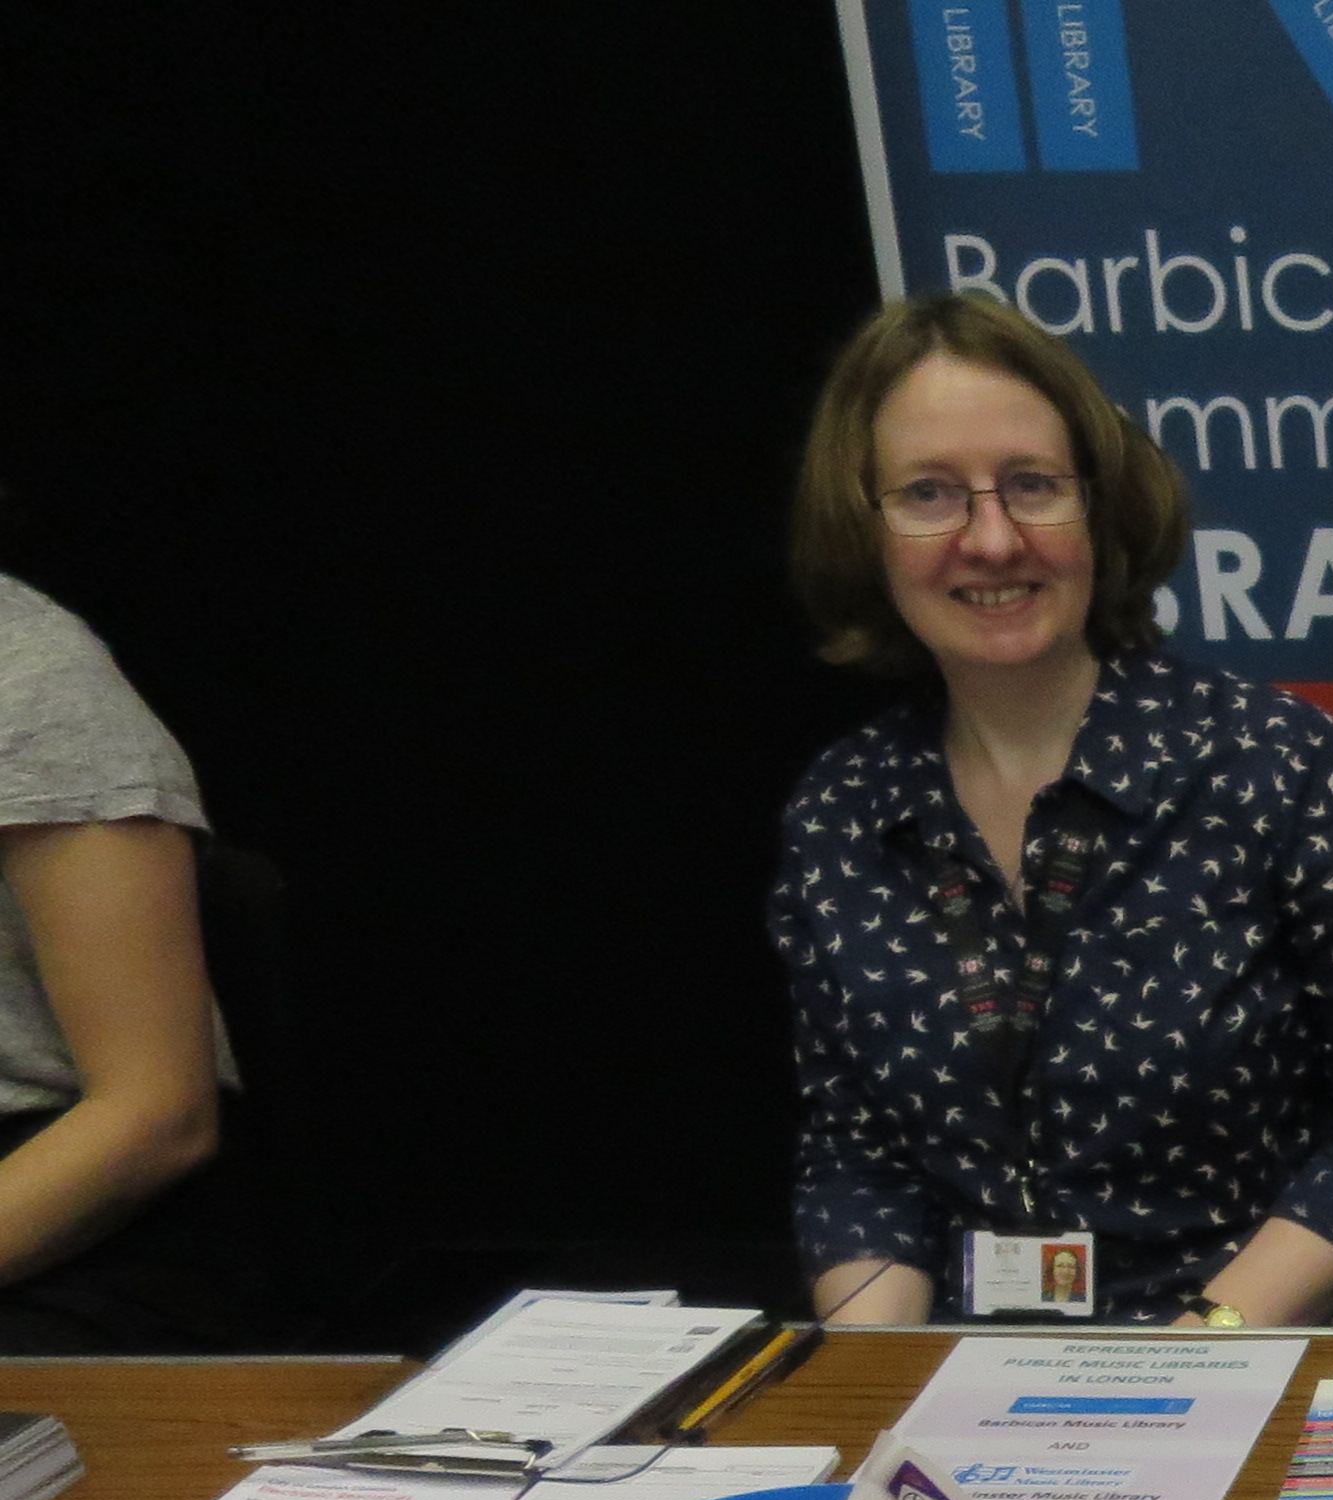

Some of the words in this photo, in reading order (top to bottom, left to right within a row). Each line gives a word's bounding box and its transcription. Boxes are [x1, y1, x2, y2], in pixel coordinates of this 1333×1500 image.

[942, 7, 986, 141] LIBRARY
[1056, 4, 1098, 138] LIBRARY
[1003, 1358, 1073, 1367] PUBLIC
[1078, 1360, 1144, 1368] MUSIC
[1149, 1360, 1248, 1368] LIBRARIES
[1063, 1345, 1208, 1354] REPRESENTING
